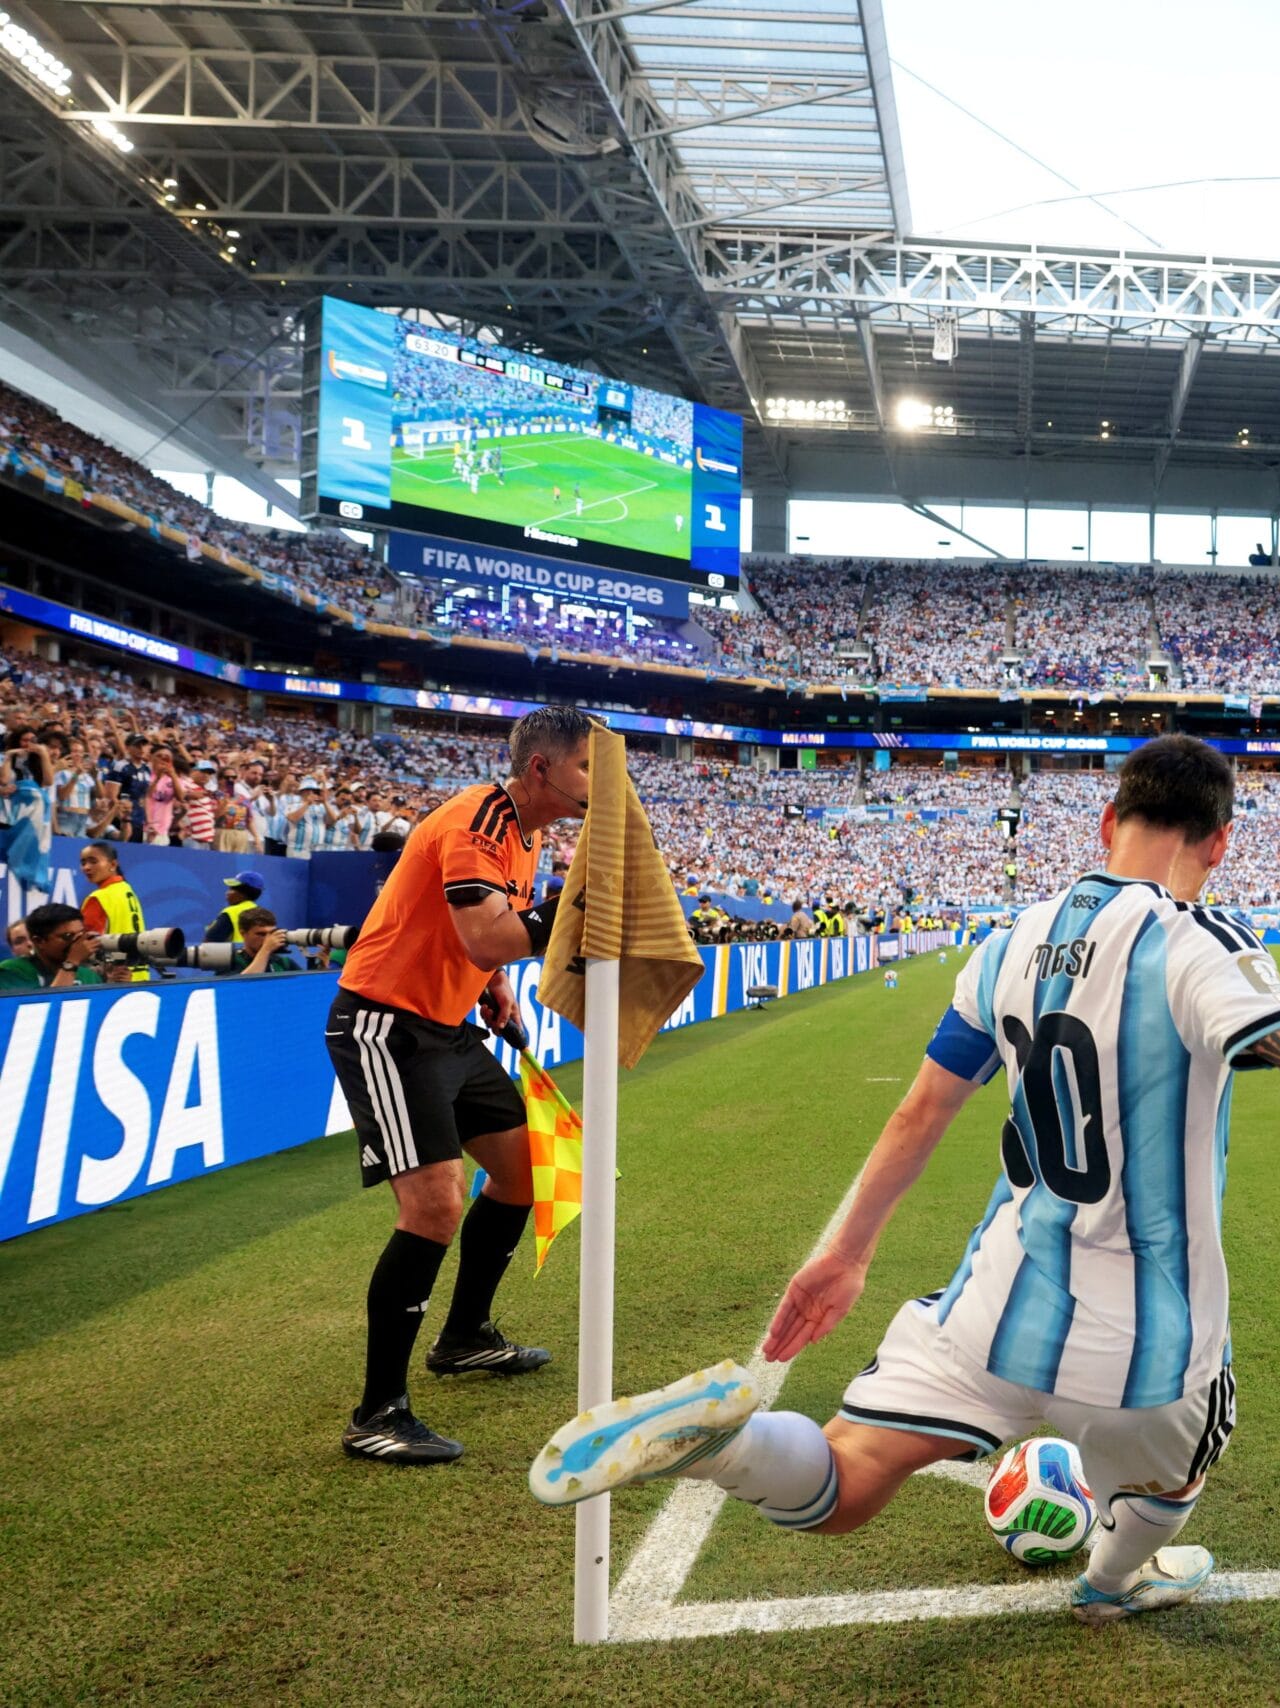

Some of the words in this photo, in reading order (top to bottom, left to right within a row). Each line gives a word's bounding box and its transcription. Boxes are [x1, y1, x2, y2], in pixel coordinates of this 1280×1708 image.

[341, 417, 371, 451] 1
[705, 504, 727, 532] 1
[524, 525, 579, 547] Hisense
[422, 547, 472, 573] FIFA
[474, 556, 551, 586] WORLD
[554, 572, 595, 593] CUP
[597, 579, 664, 605] 2026
[284, 677, 341, 696] MIAMI
[782, 732, 824, 745] MIAMI
[971, 736, 998, 748] FIFA
[998, 736, 1041, 749] WORLD
[1041, 738, 1066, 749] CUP
[1066, 738, 1108, 750] 2026
[739, 943, 769, 1007] VISA
[796, 941, 815, 991] VISA
[1001, 1011, 1111, 1204] 10
